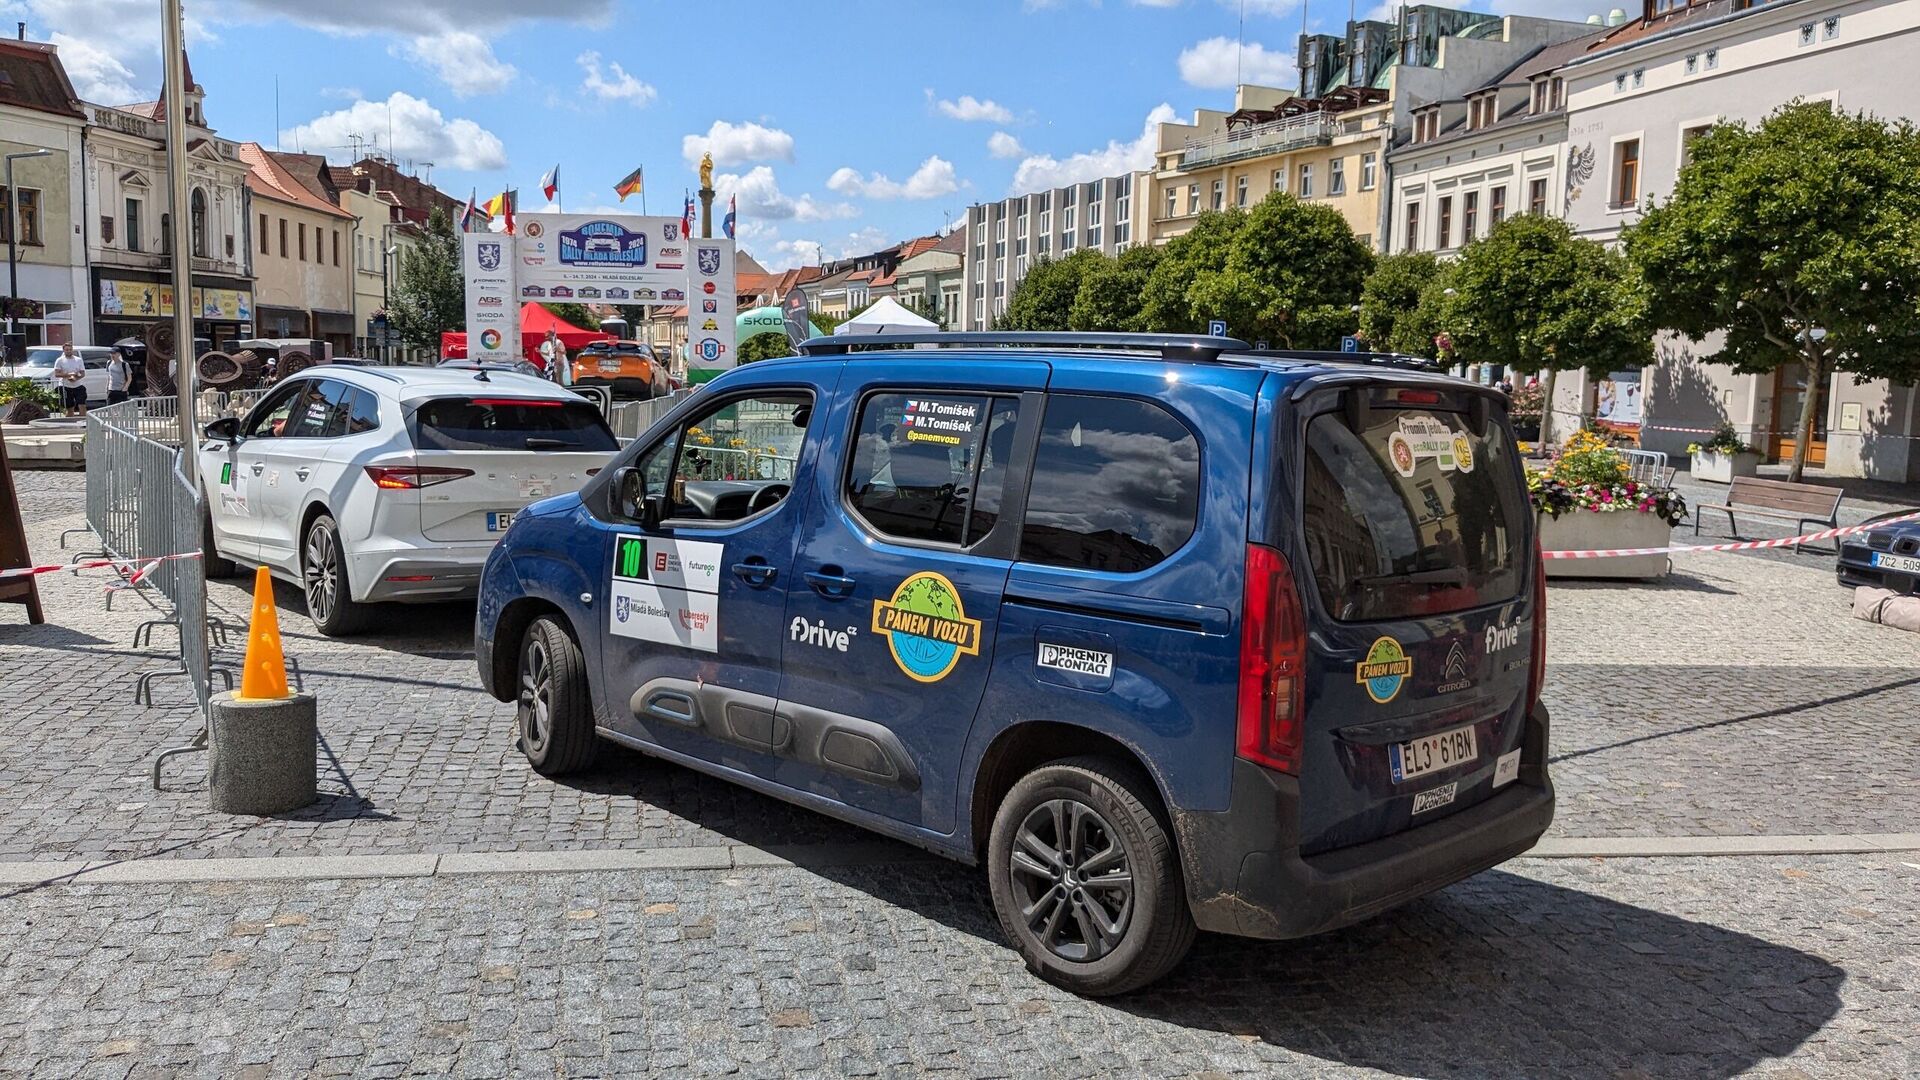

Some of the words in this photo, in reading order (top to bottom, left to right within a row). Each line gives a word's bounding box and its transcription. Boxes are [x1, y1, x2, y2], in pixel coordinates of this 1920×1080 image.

[581, 223, 624, 237] BOHEMIA
[561, 235, 578, 248] 1974
[628, 237, 644, 250] 2024
[562, 244, 583, 260] RALLY
[609, 246, 644, 262] BOLESLAV
[918, 401, 976, 417] M.Tomíšek
[915, 415, 972, 432] M.Tomíšek
[907, 430, 960, 445] @panemvozu
[622, 540, 642, 577] 10
[1879, 555, 1897, 568] 7C2
[630, 602, 647, 616] Mladá
[647, 605, 670, 619] Boleslav
[683, 609, 709, 623] Liberecký
[694, 620, 705, 632] kraj
[884, 608, 930, 636] PÁNEM
[932, 619, 968, 644] VOZU
[1057, 657, 1107, 675] CONTACT
[1389, 661, 1406, 675] VOZU
[1403, 741, 1432, 775] EL3
[1440, 729, 1472, 763] 61BN
[1393, 767, 1401, 777] CZ
[1424, 794, 1453, 810] CONTACT
